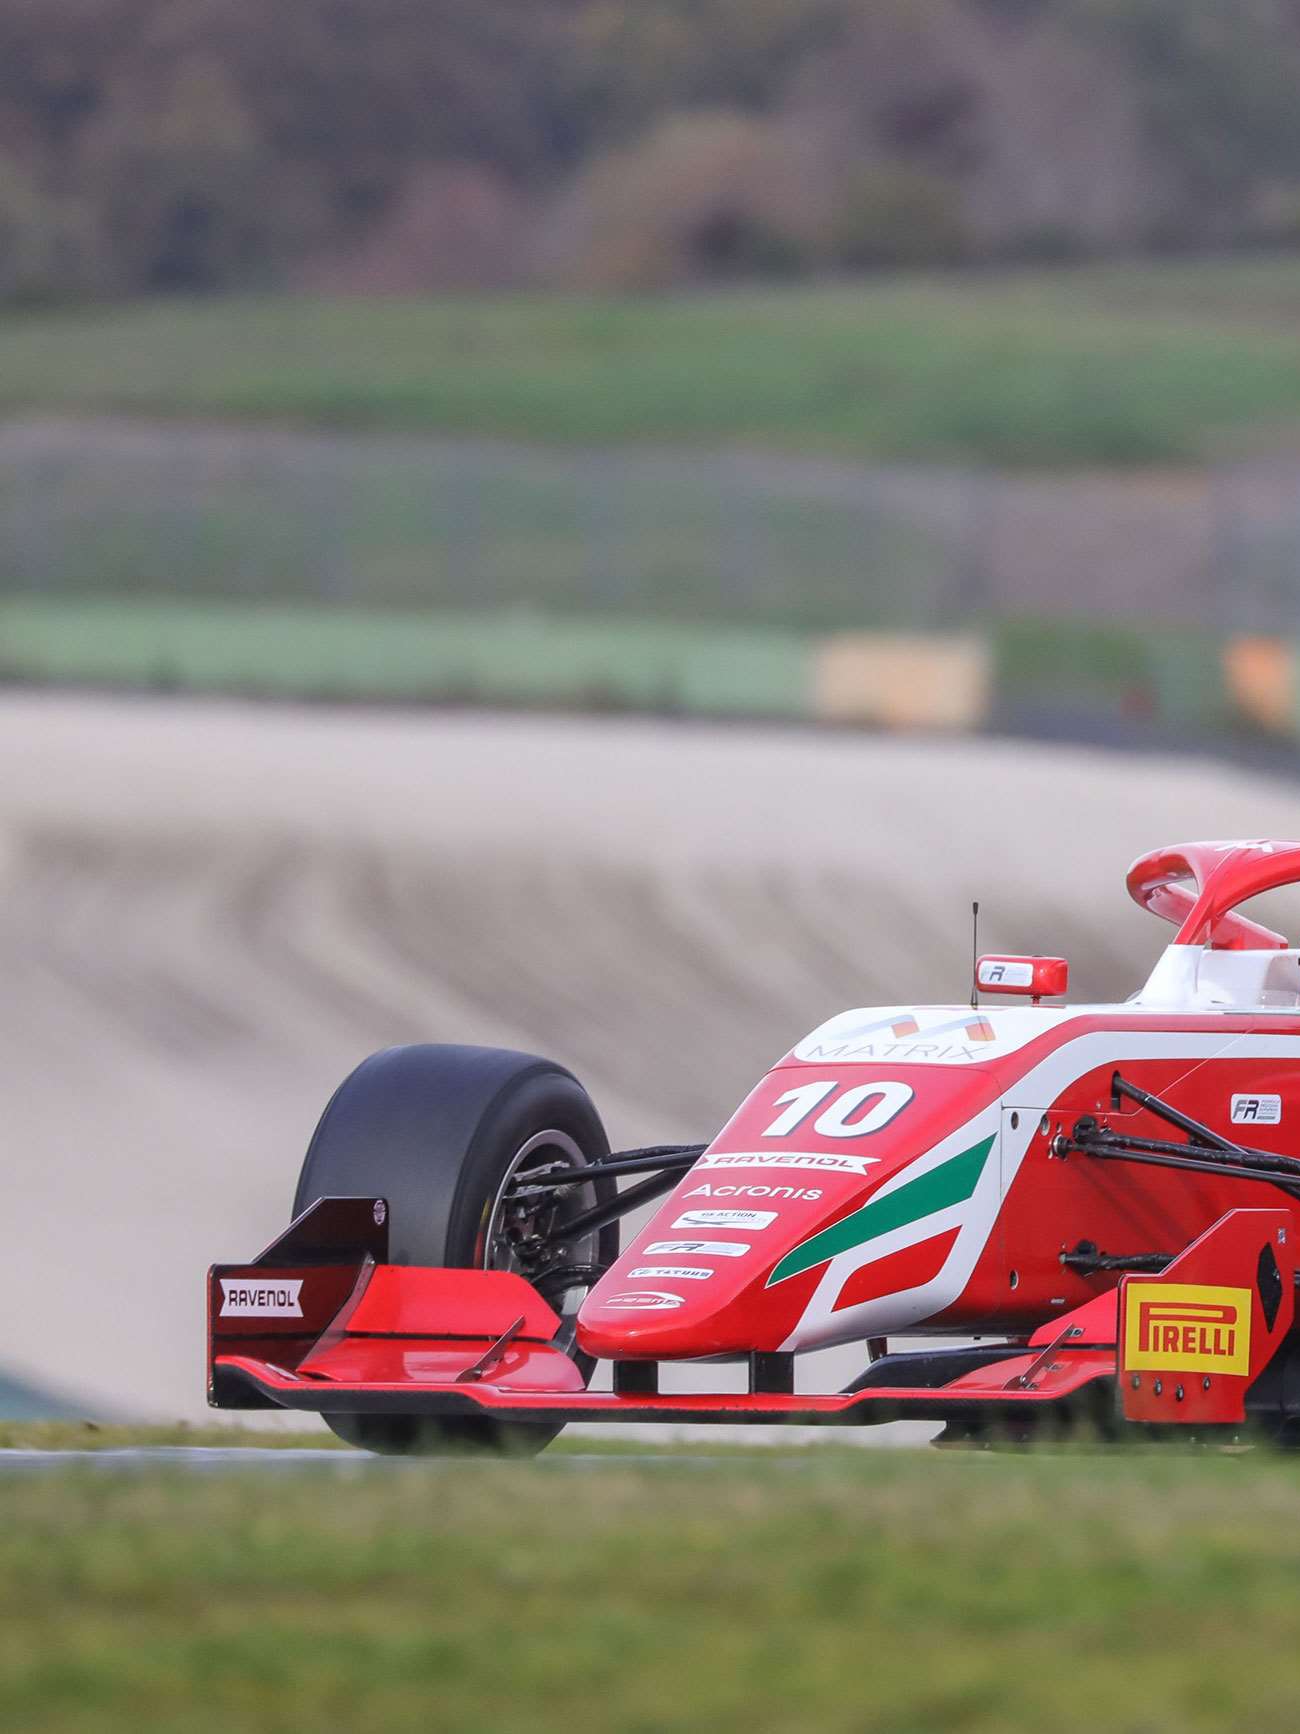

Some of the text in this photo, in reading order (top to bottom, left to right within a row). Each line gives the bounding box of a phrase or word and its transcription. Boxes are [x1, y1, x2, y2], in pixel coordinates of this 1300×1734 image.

[805, 1044, 986, 1060] MATRIX
[760, 1081, 915, 1138] 10
[1232, 1099, 1260, 1119] FR
[713, 1155, 854, 1168] RAVENOL
[682, 1183, 824, 1201] Acronis
[228, 1289, 295, 1307] RAVENOL
[1138, 1301, 1238, 1357] PIRELLI
